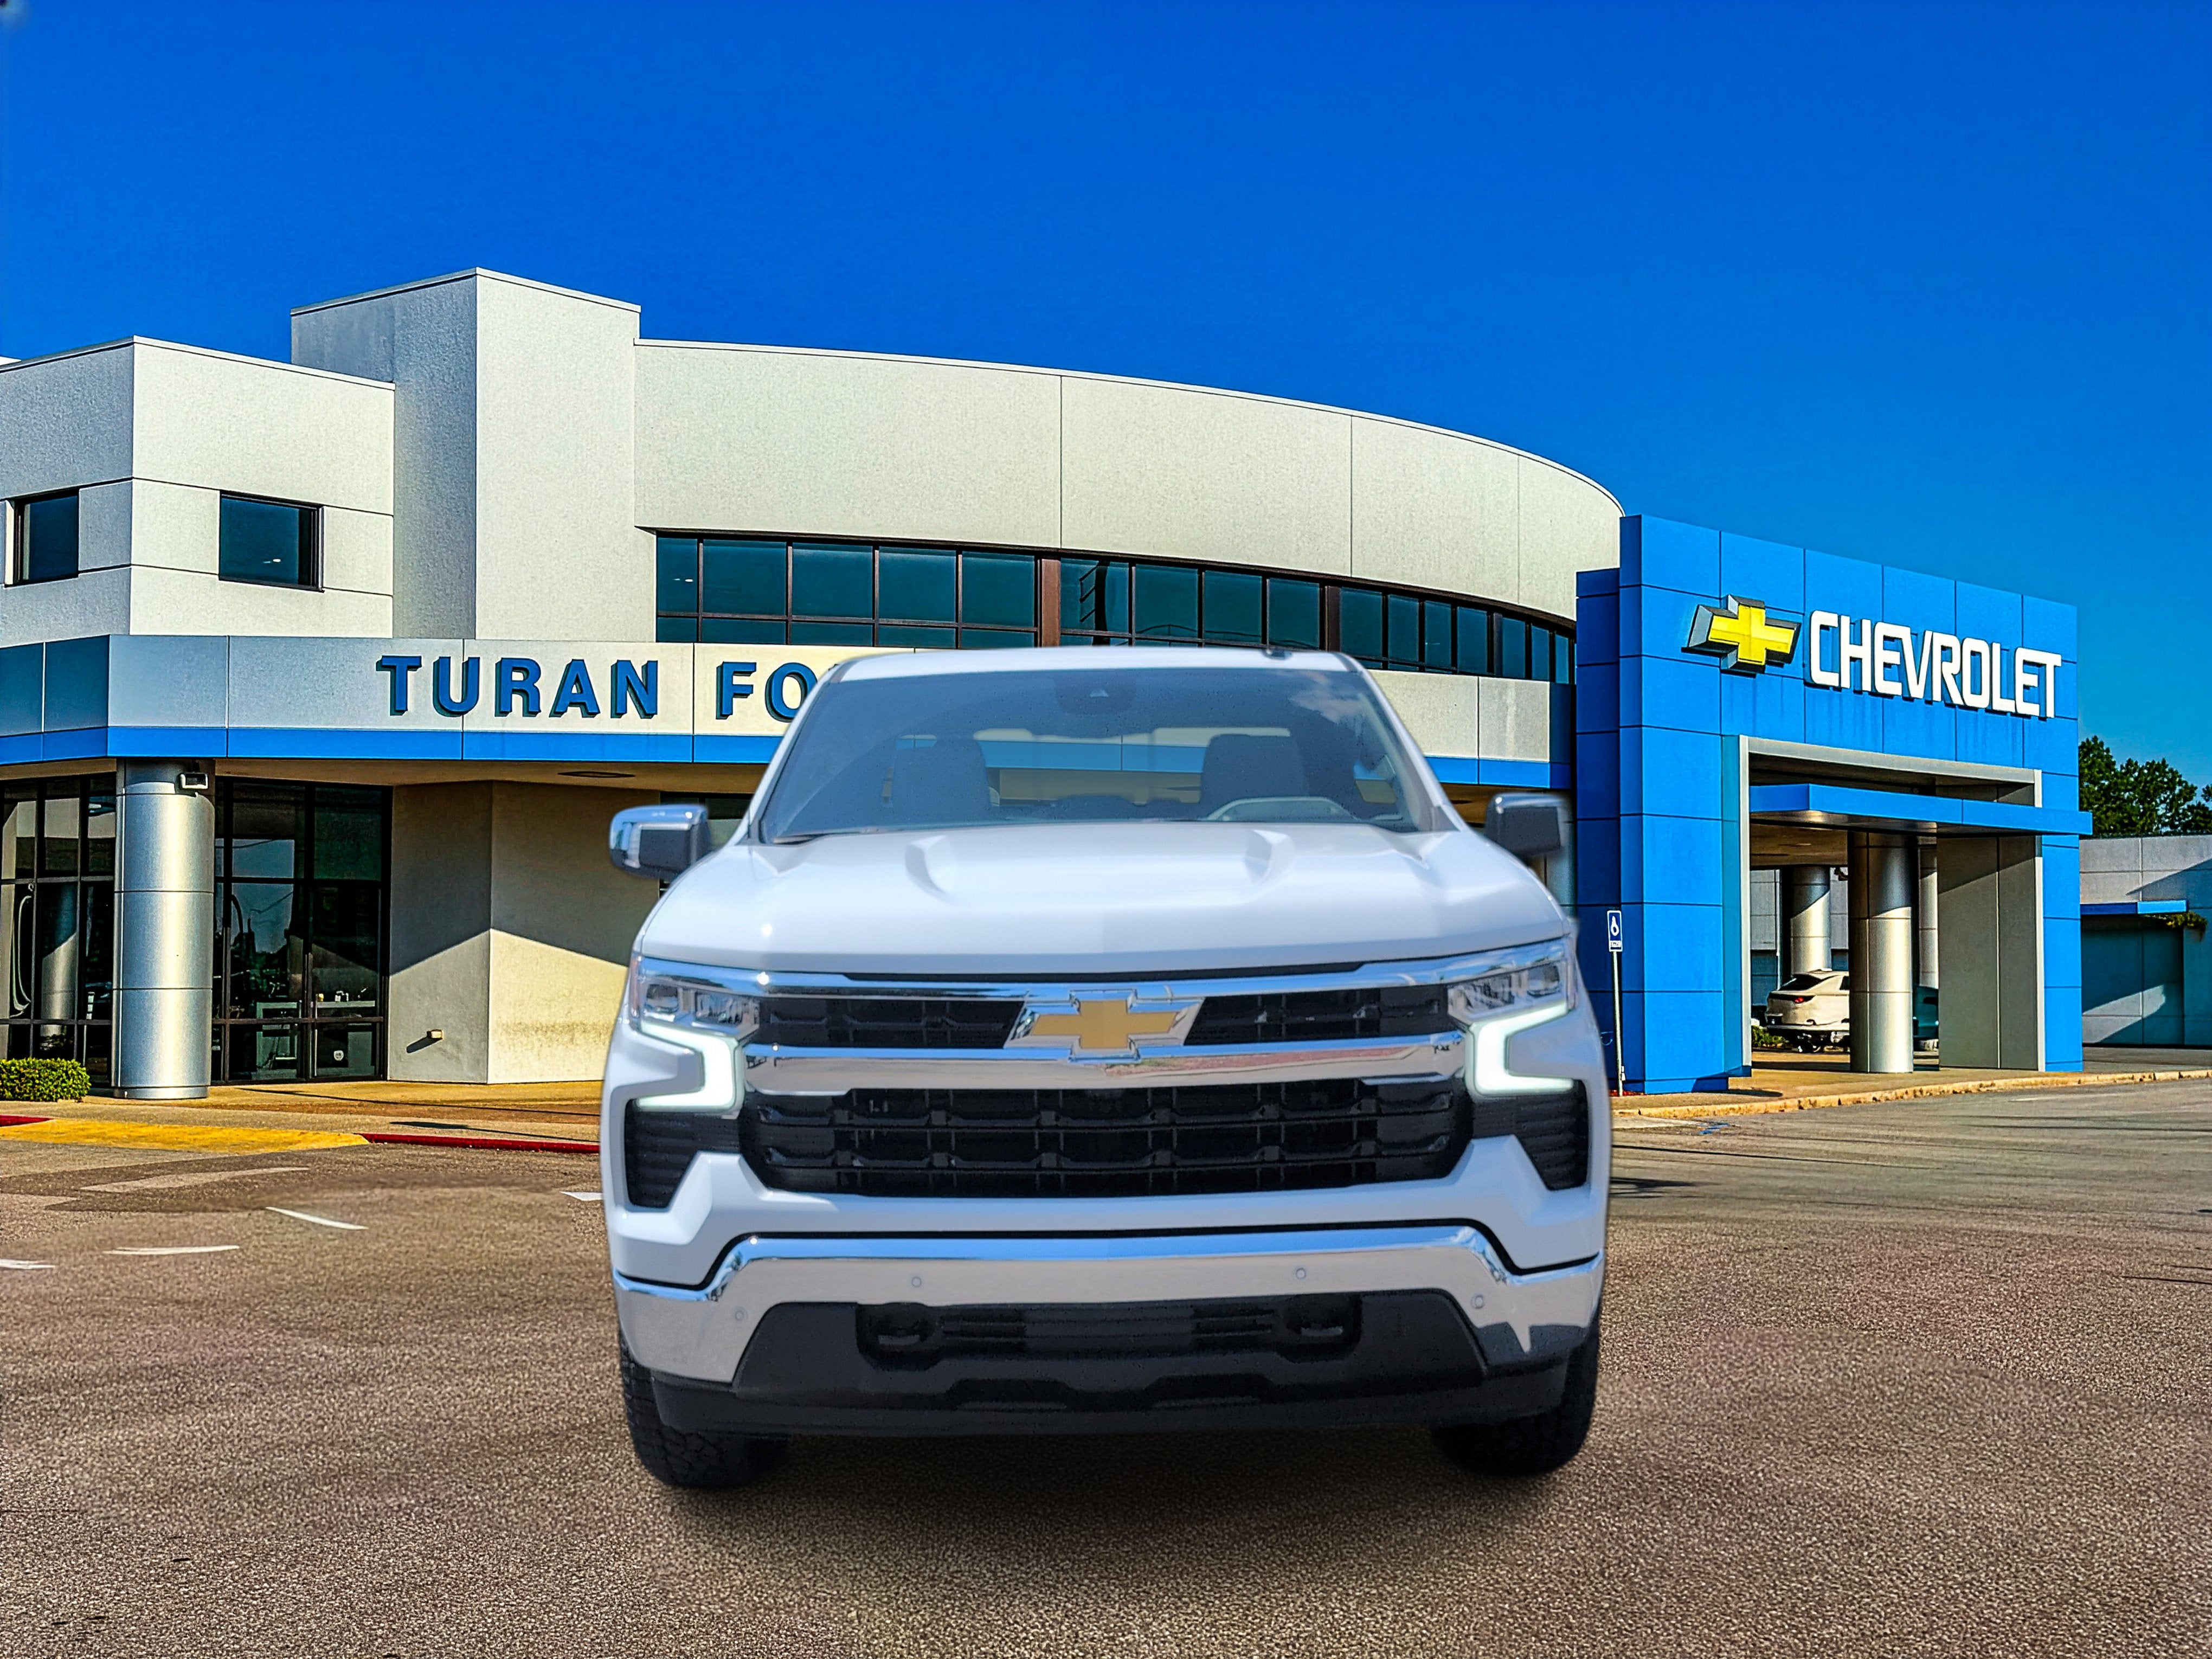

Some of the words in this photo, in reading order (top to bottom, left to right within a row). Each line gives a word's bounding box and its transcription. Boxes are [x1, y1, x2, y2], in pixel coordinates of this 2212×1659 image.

[376, 655, 658, 719] TURAN
[716, 661, 838, 723] FO
[1807, 610, 2062, 719] CHEVROLET
